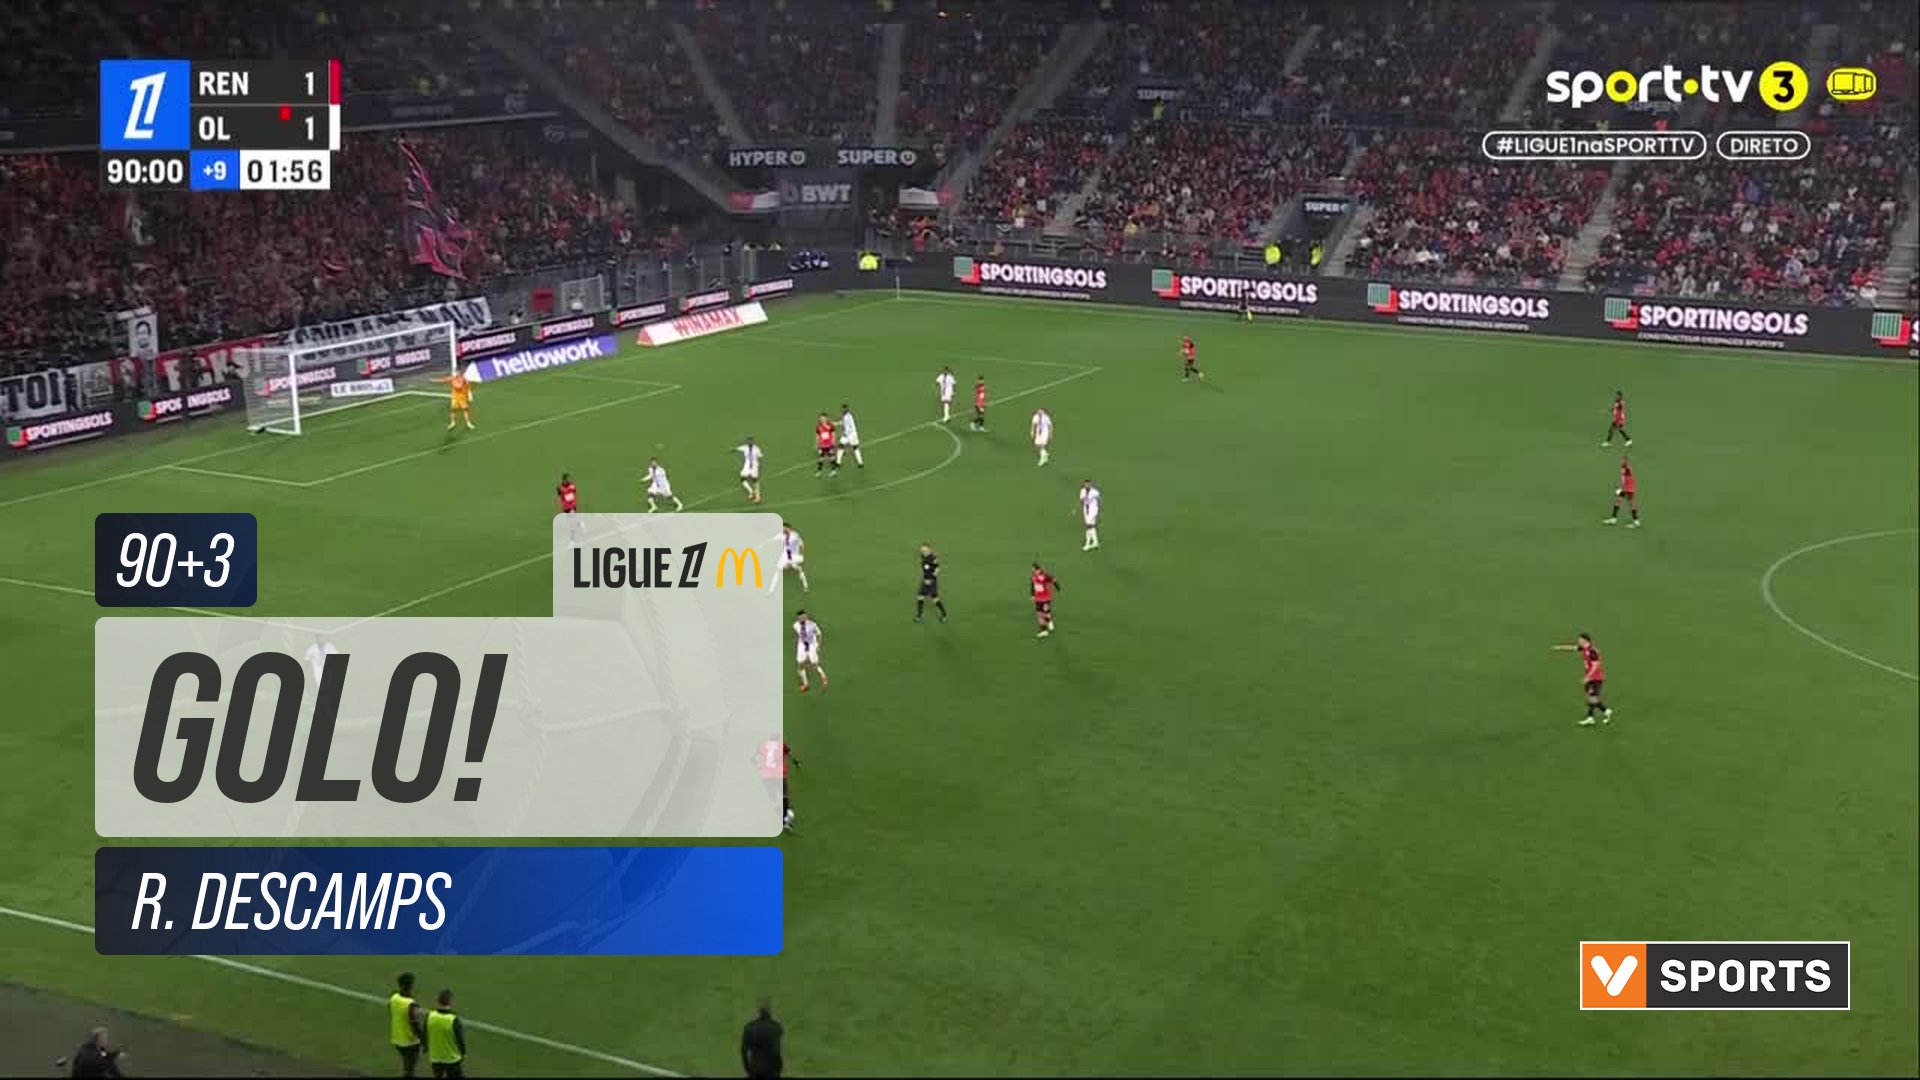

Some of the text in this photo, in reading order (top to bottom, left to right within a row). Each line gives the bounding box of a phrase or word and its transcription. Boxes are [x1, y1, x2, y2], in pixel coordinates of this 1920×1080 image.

[729, 151, 788, 167] HYPER
[837, 149, 898, 166] SUPER
[803, 184, 850, 202] BWT
[980, 263, 1107, 289] SPORTINGSOLS
[1399, 290, 1550, 319] SPORTINGSOLS
[671, 306, 744, 338] WINAMAX
[1639, 305, 1809, 335] SPORTINGSOLS
[491, 337, 603, 378] hellowork
